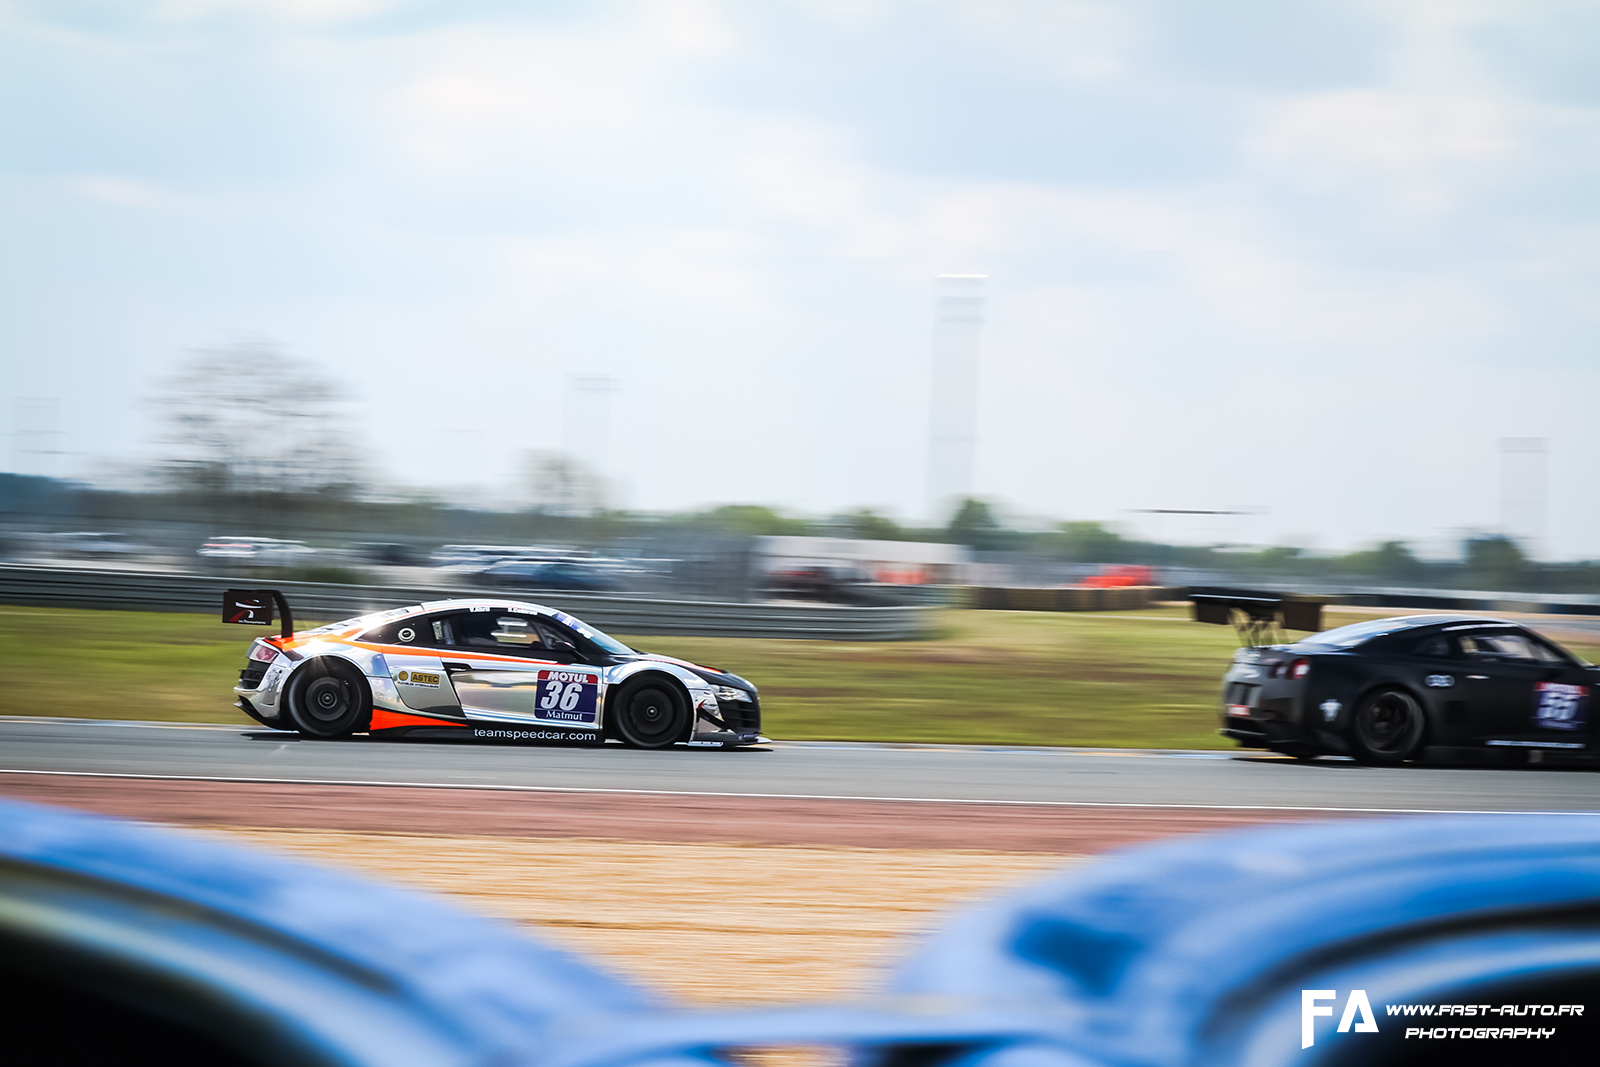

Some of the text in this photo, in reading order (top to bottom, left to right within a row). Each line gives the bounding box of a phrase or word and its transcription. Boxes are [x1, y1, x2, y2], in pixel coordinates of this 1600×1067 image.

[412, 673, 440, 684] ASTEC
[547, 671, 589, 684] MOTUL
[540, 681, 583, 711] 36
[546, 710, 584, 721] Matmut
[473, 728, 596, 741] teamspeedcar.com
